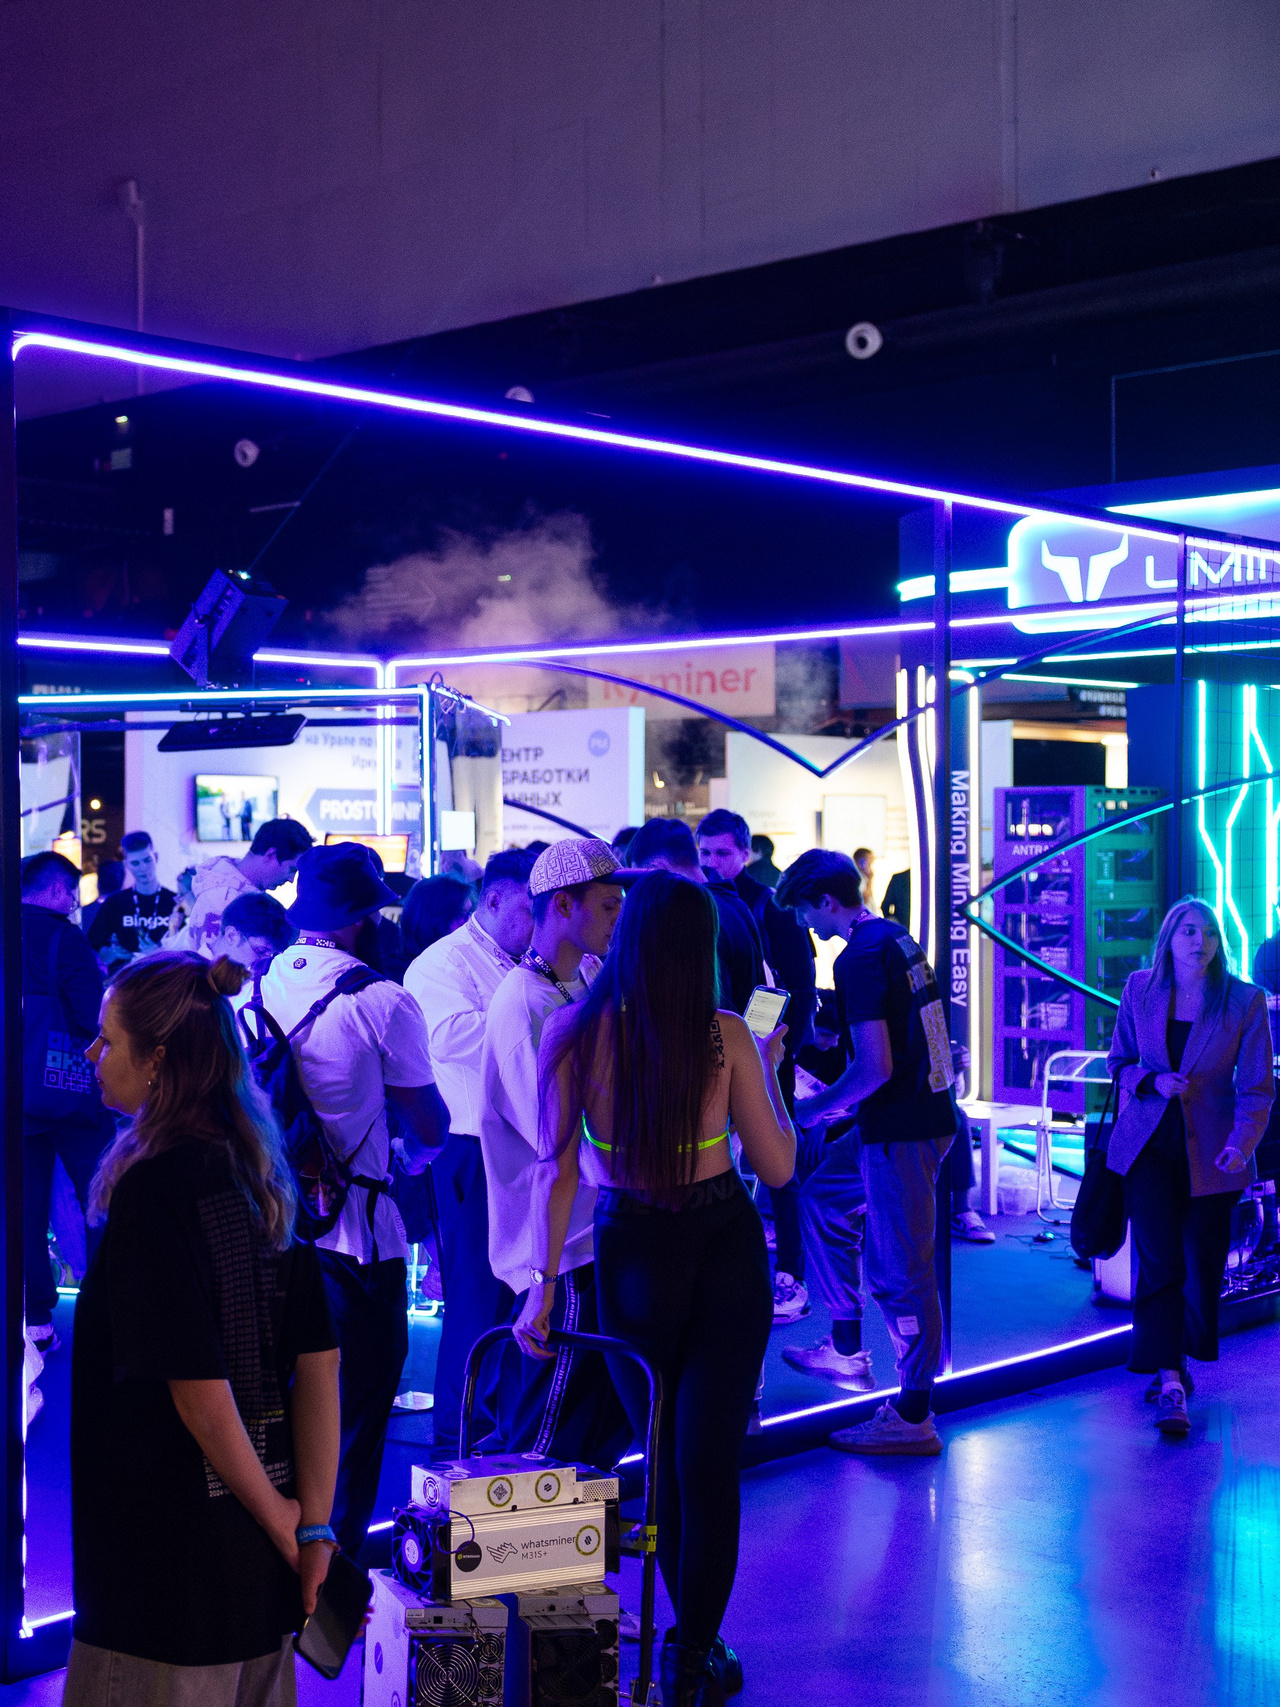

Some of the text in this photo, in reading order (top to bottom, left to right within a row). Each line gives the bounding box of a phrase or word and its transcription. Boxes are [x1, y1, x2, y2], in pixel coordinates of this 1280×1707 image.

[500, 747, 544, 764] ЕНТР
[500, 768, 590, 786] БРАБОТКИ
[951, 771, 970, 1007] Making Minng Easy
[122, 915, 170, 928] BingX
[521, 1536, 576, 1550] whatsminer
[521, 1552, 548, 1560] M31S+
